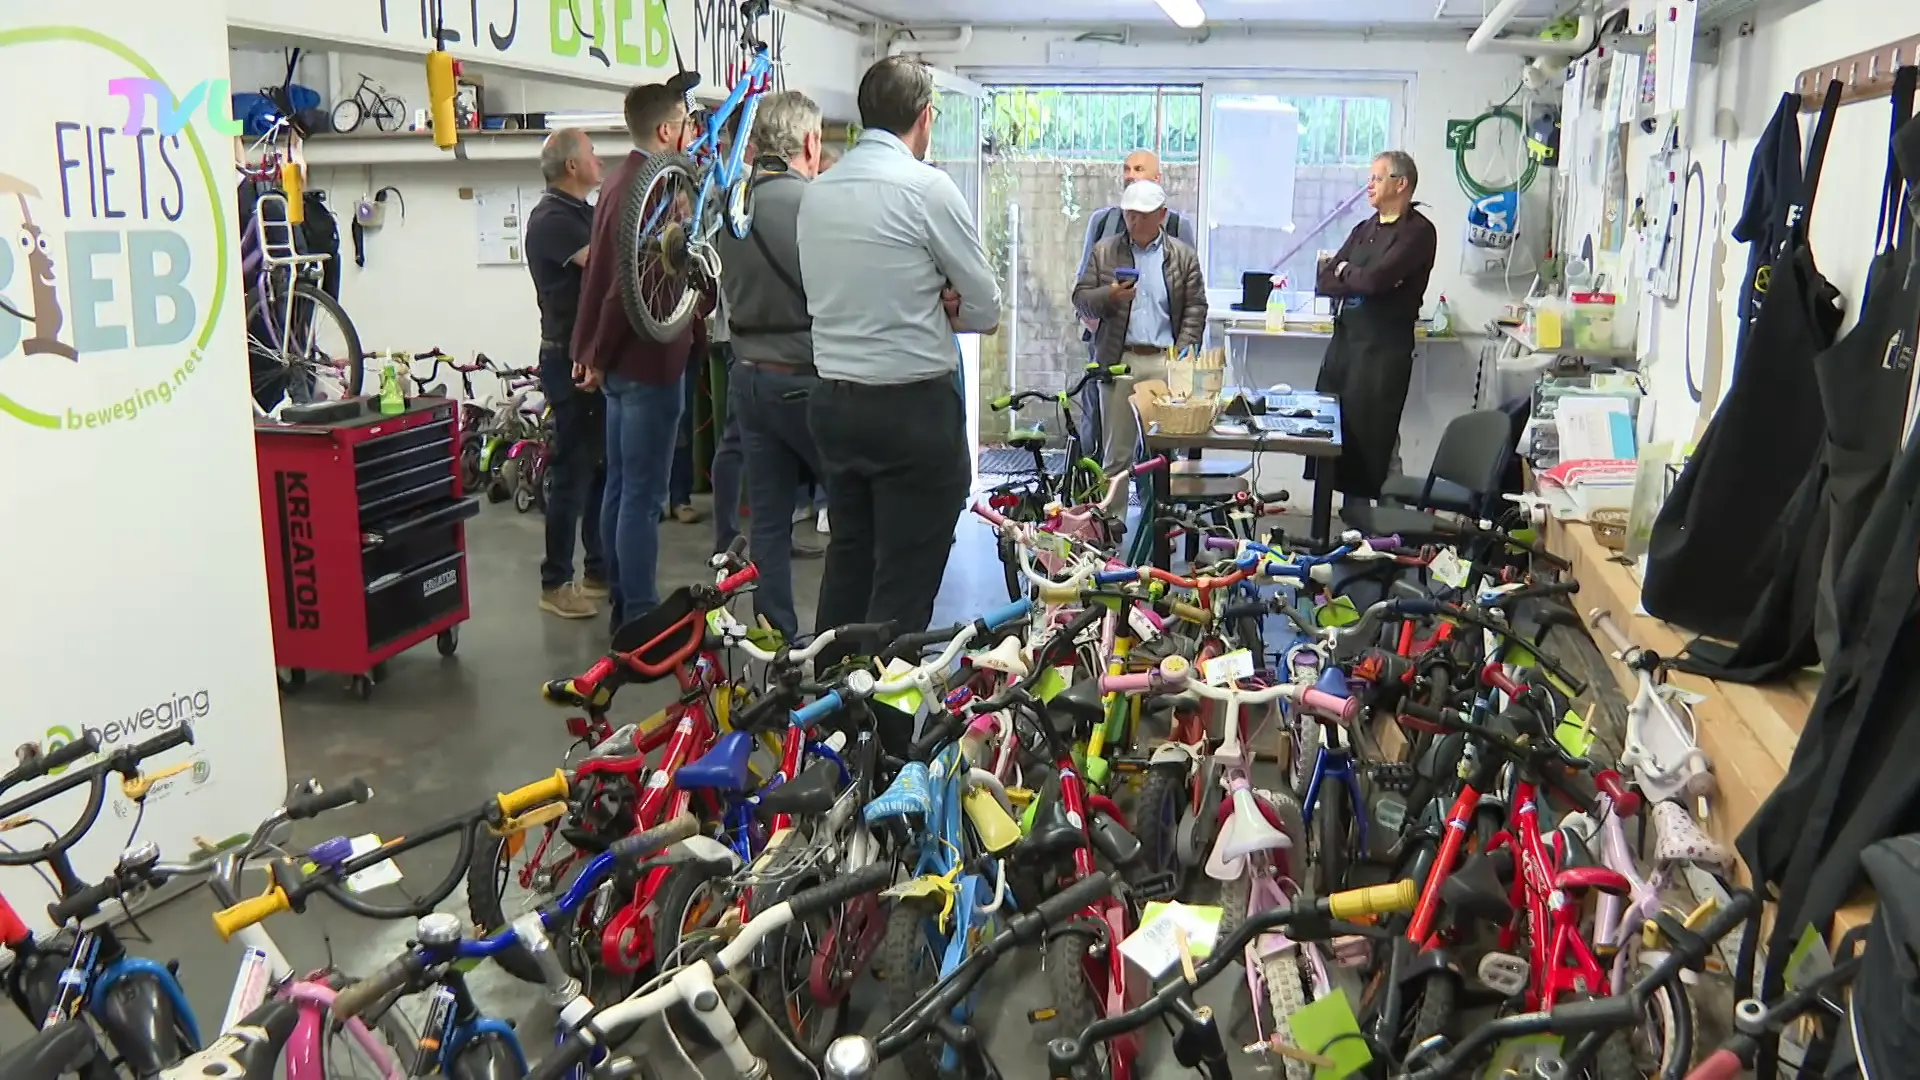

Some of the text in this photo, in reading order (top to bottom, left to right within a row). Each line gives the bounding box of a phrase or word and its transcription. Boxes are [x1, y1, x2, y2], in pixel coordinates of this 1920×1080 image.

[56, 121, 184, 222] FIETS
[67, 347, 203, 430] beweging.net
[286, 471, 320, 630] KREATOR
